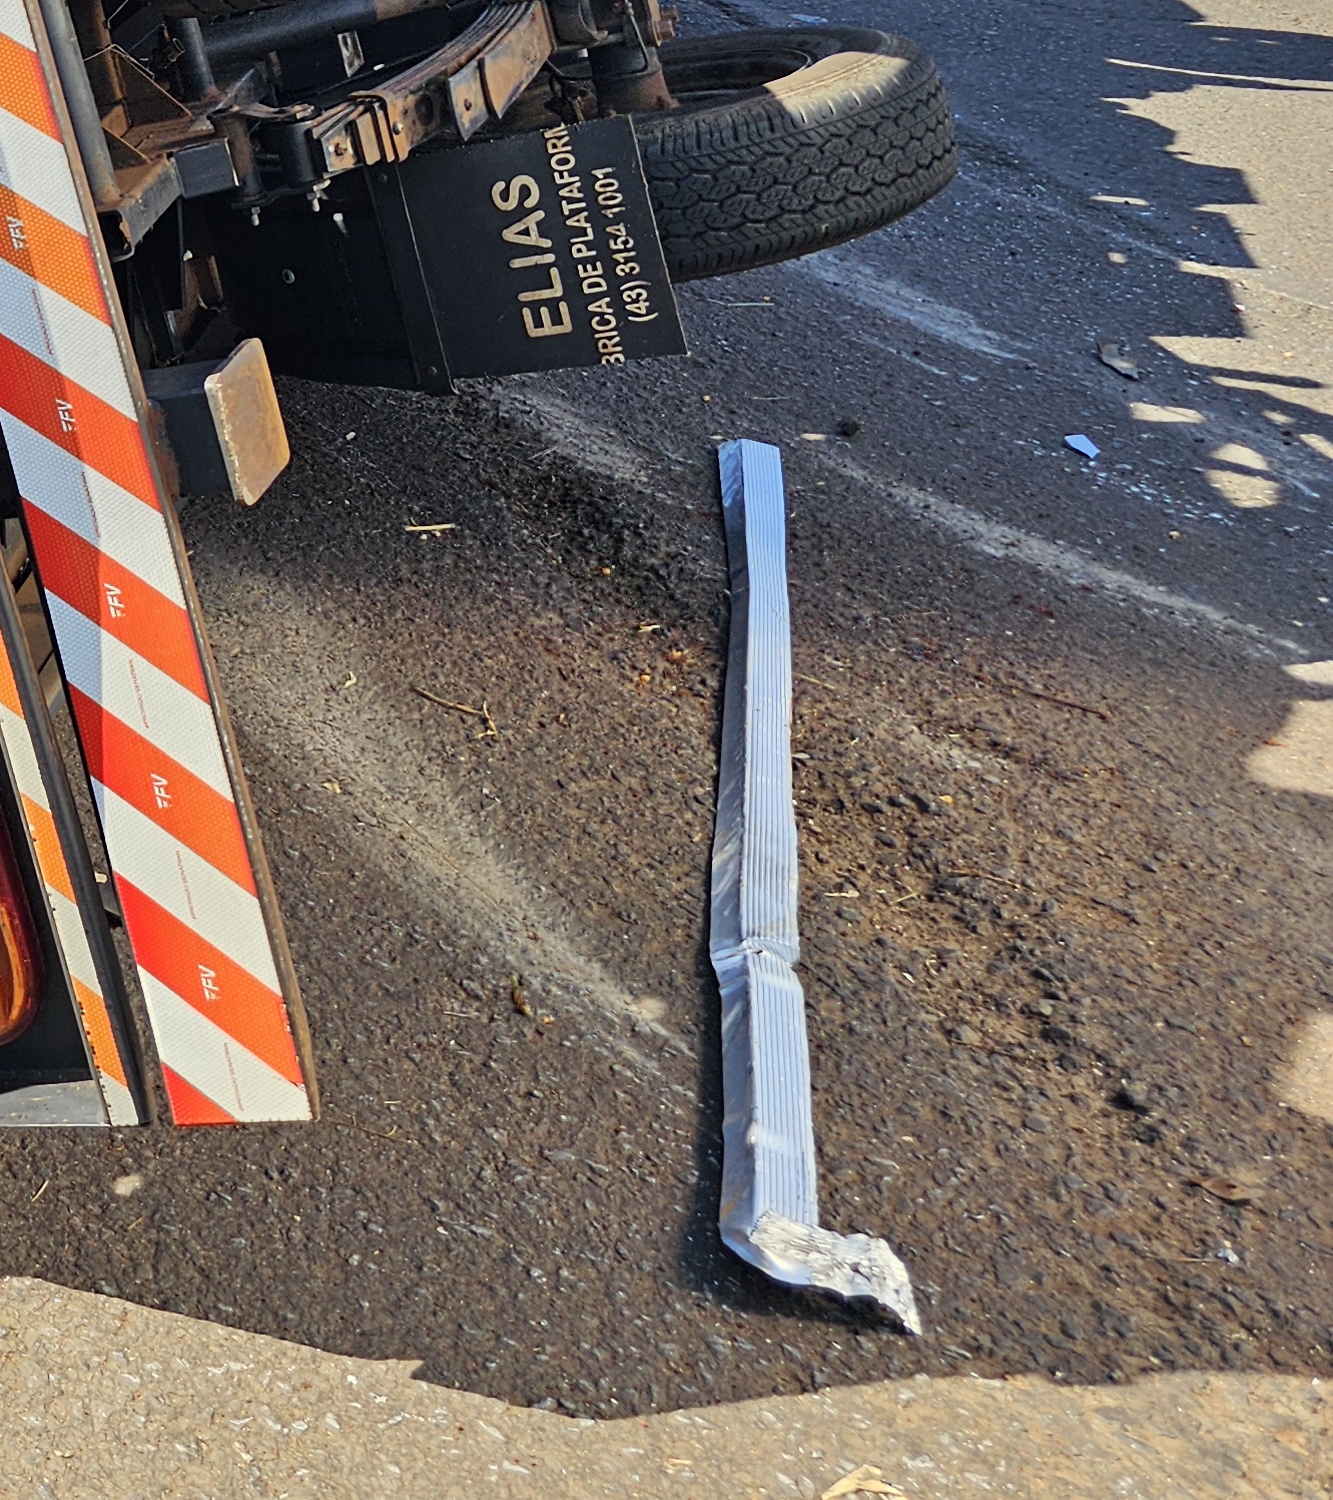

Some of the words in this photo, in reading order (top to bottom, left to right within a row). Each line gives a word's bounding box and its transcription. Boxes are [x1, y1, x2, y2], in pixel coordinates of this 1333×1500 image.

[591, 167, 626, 218] 1001
[491, 174, 572, 338] ELIAS
[606, 223, 640, 276] 3154
[577, 261, 608, 295] DE
[619, 281, 658, 322] (43)
